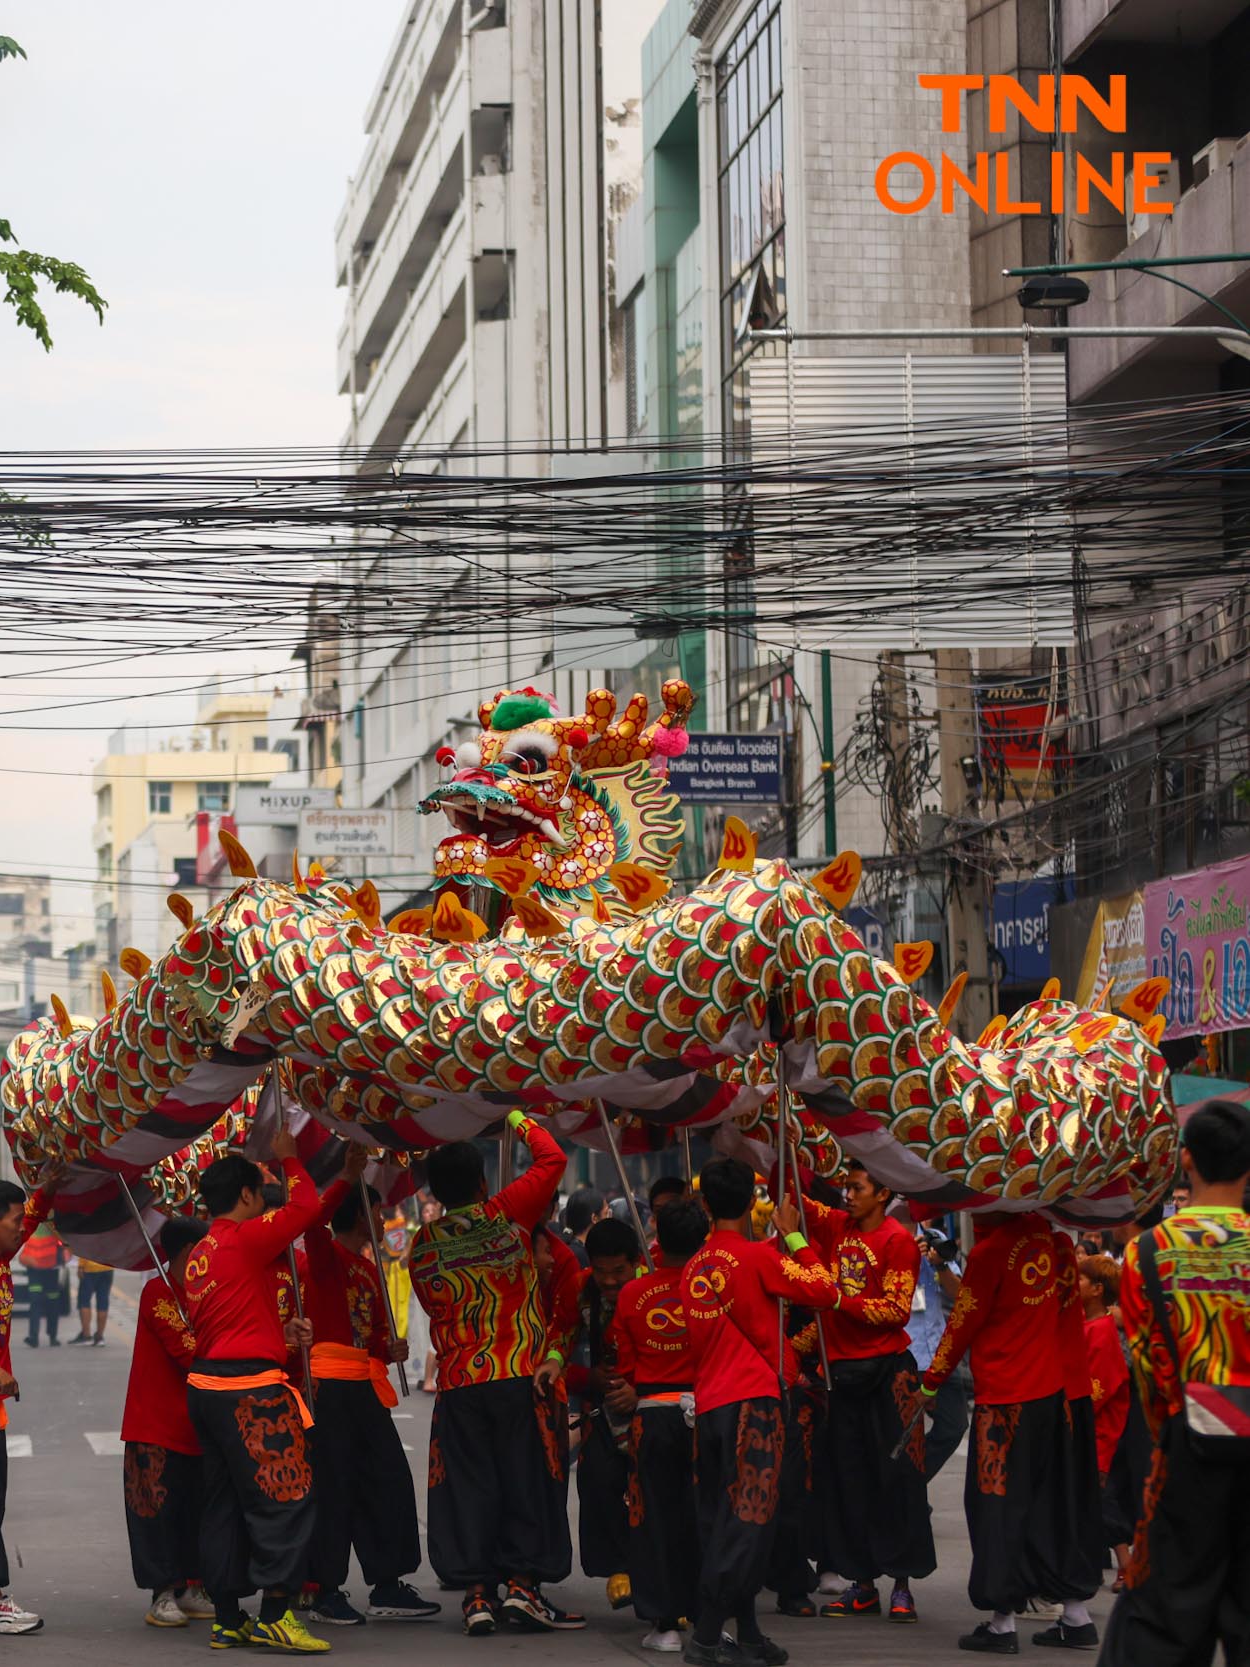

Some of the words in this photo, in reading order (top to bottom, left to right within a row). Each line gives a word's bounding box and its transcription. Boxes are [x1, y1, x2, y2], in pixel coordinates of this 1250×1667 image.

[701, 740, 734, 755] อินเดียน
[670, 760, 699, 773] Indian
[701, 760, 749, 773] Overseas
[751, 760, 778, 773] Bank
[690, 779, 726, 789] Bangkok
[727, 779, 756, 788] Branch
[635, 1283, 671, 1311] CHINESE
